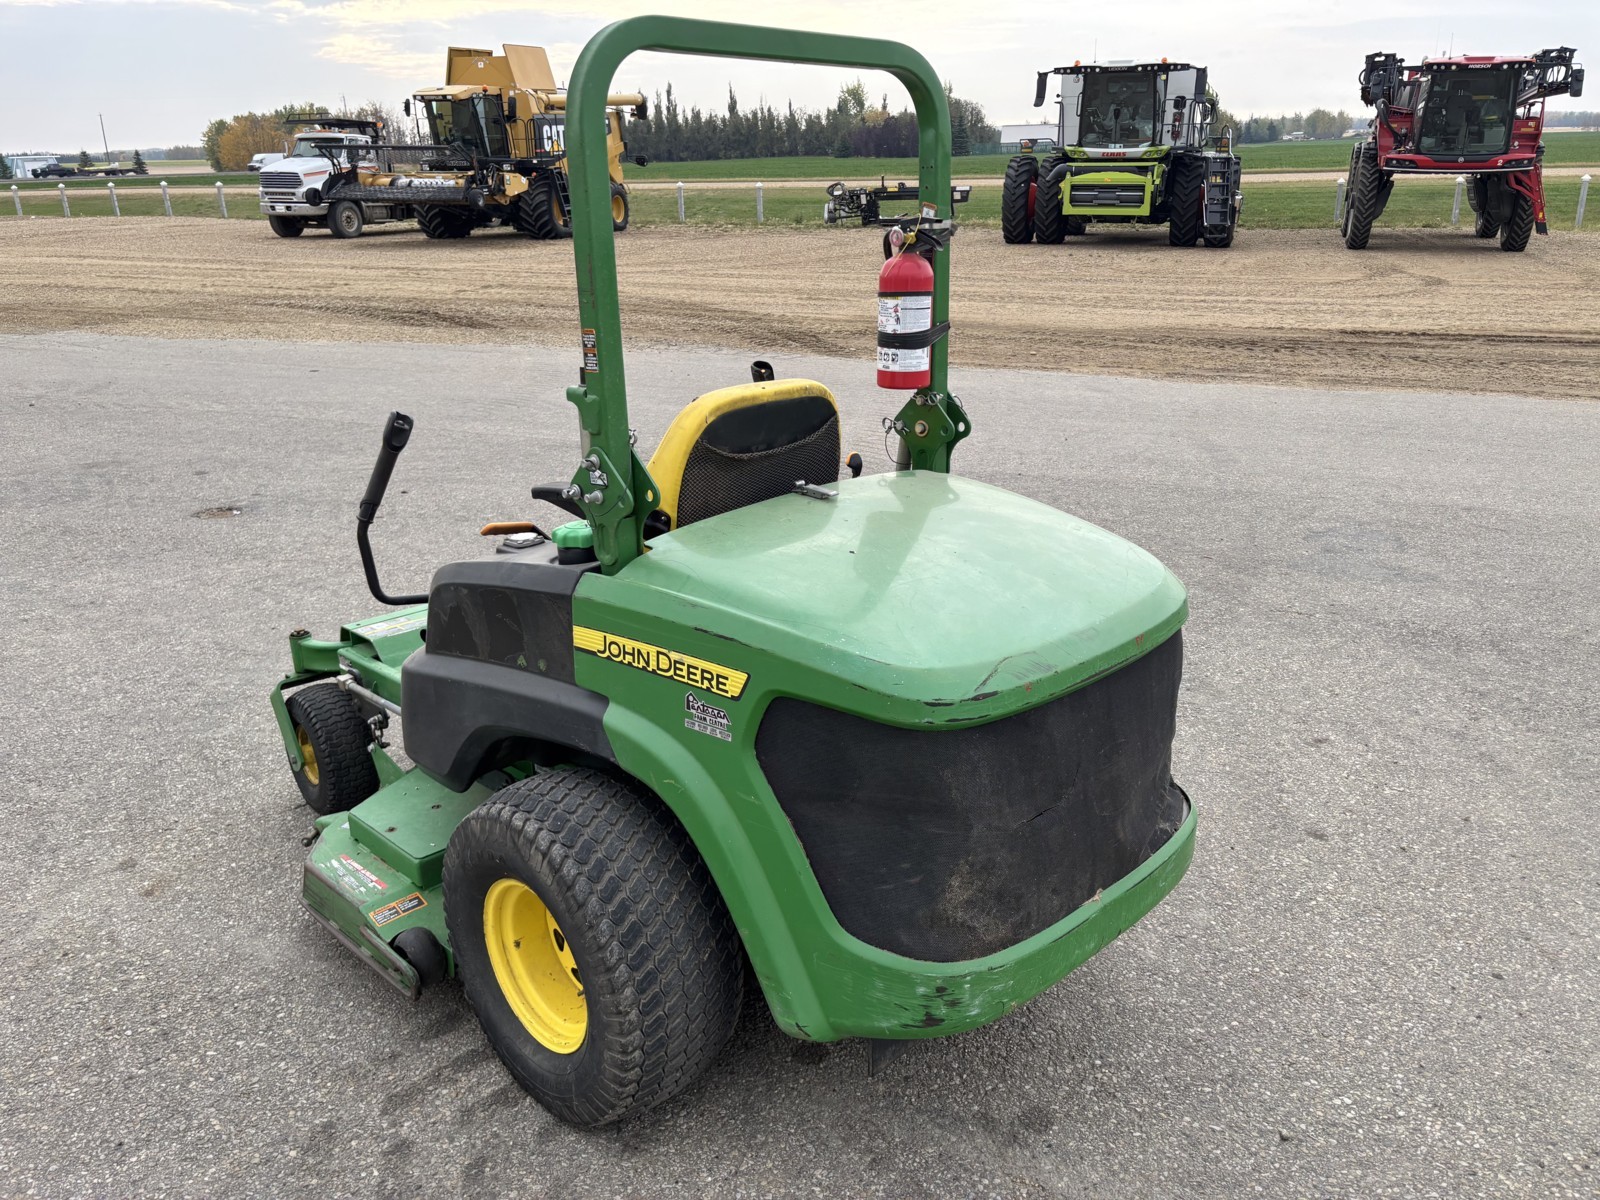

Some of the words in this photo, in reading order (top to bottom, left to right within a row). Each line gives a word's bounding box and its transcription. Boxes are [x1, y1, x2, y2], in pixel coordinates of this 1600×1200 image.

[543, 124, 565, 152] CAT
[597, 635, 650, 668] JOHN
[656, 650, 729, 694] DEERE
[694, 713, 708, 723] FARM
